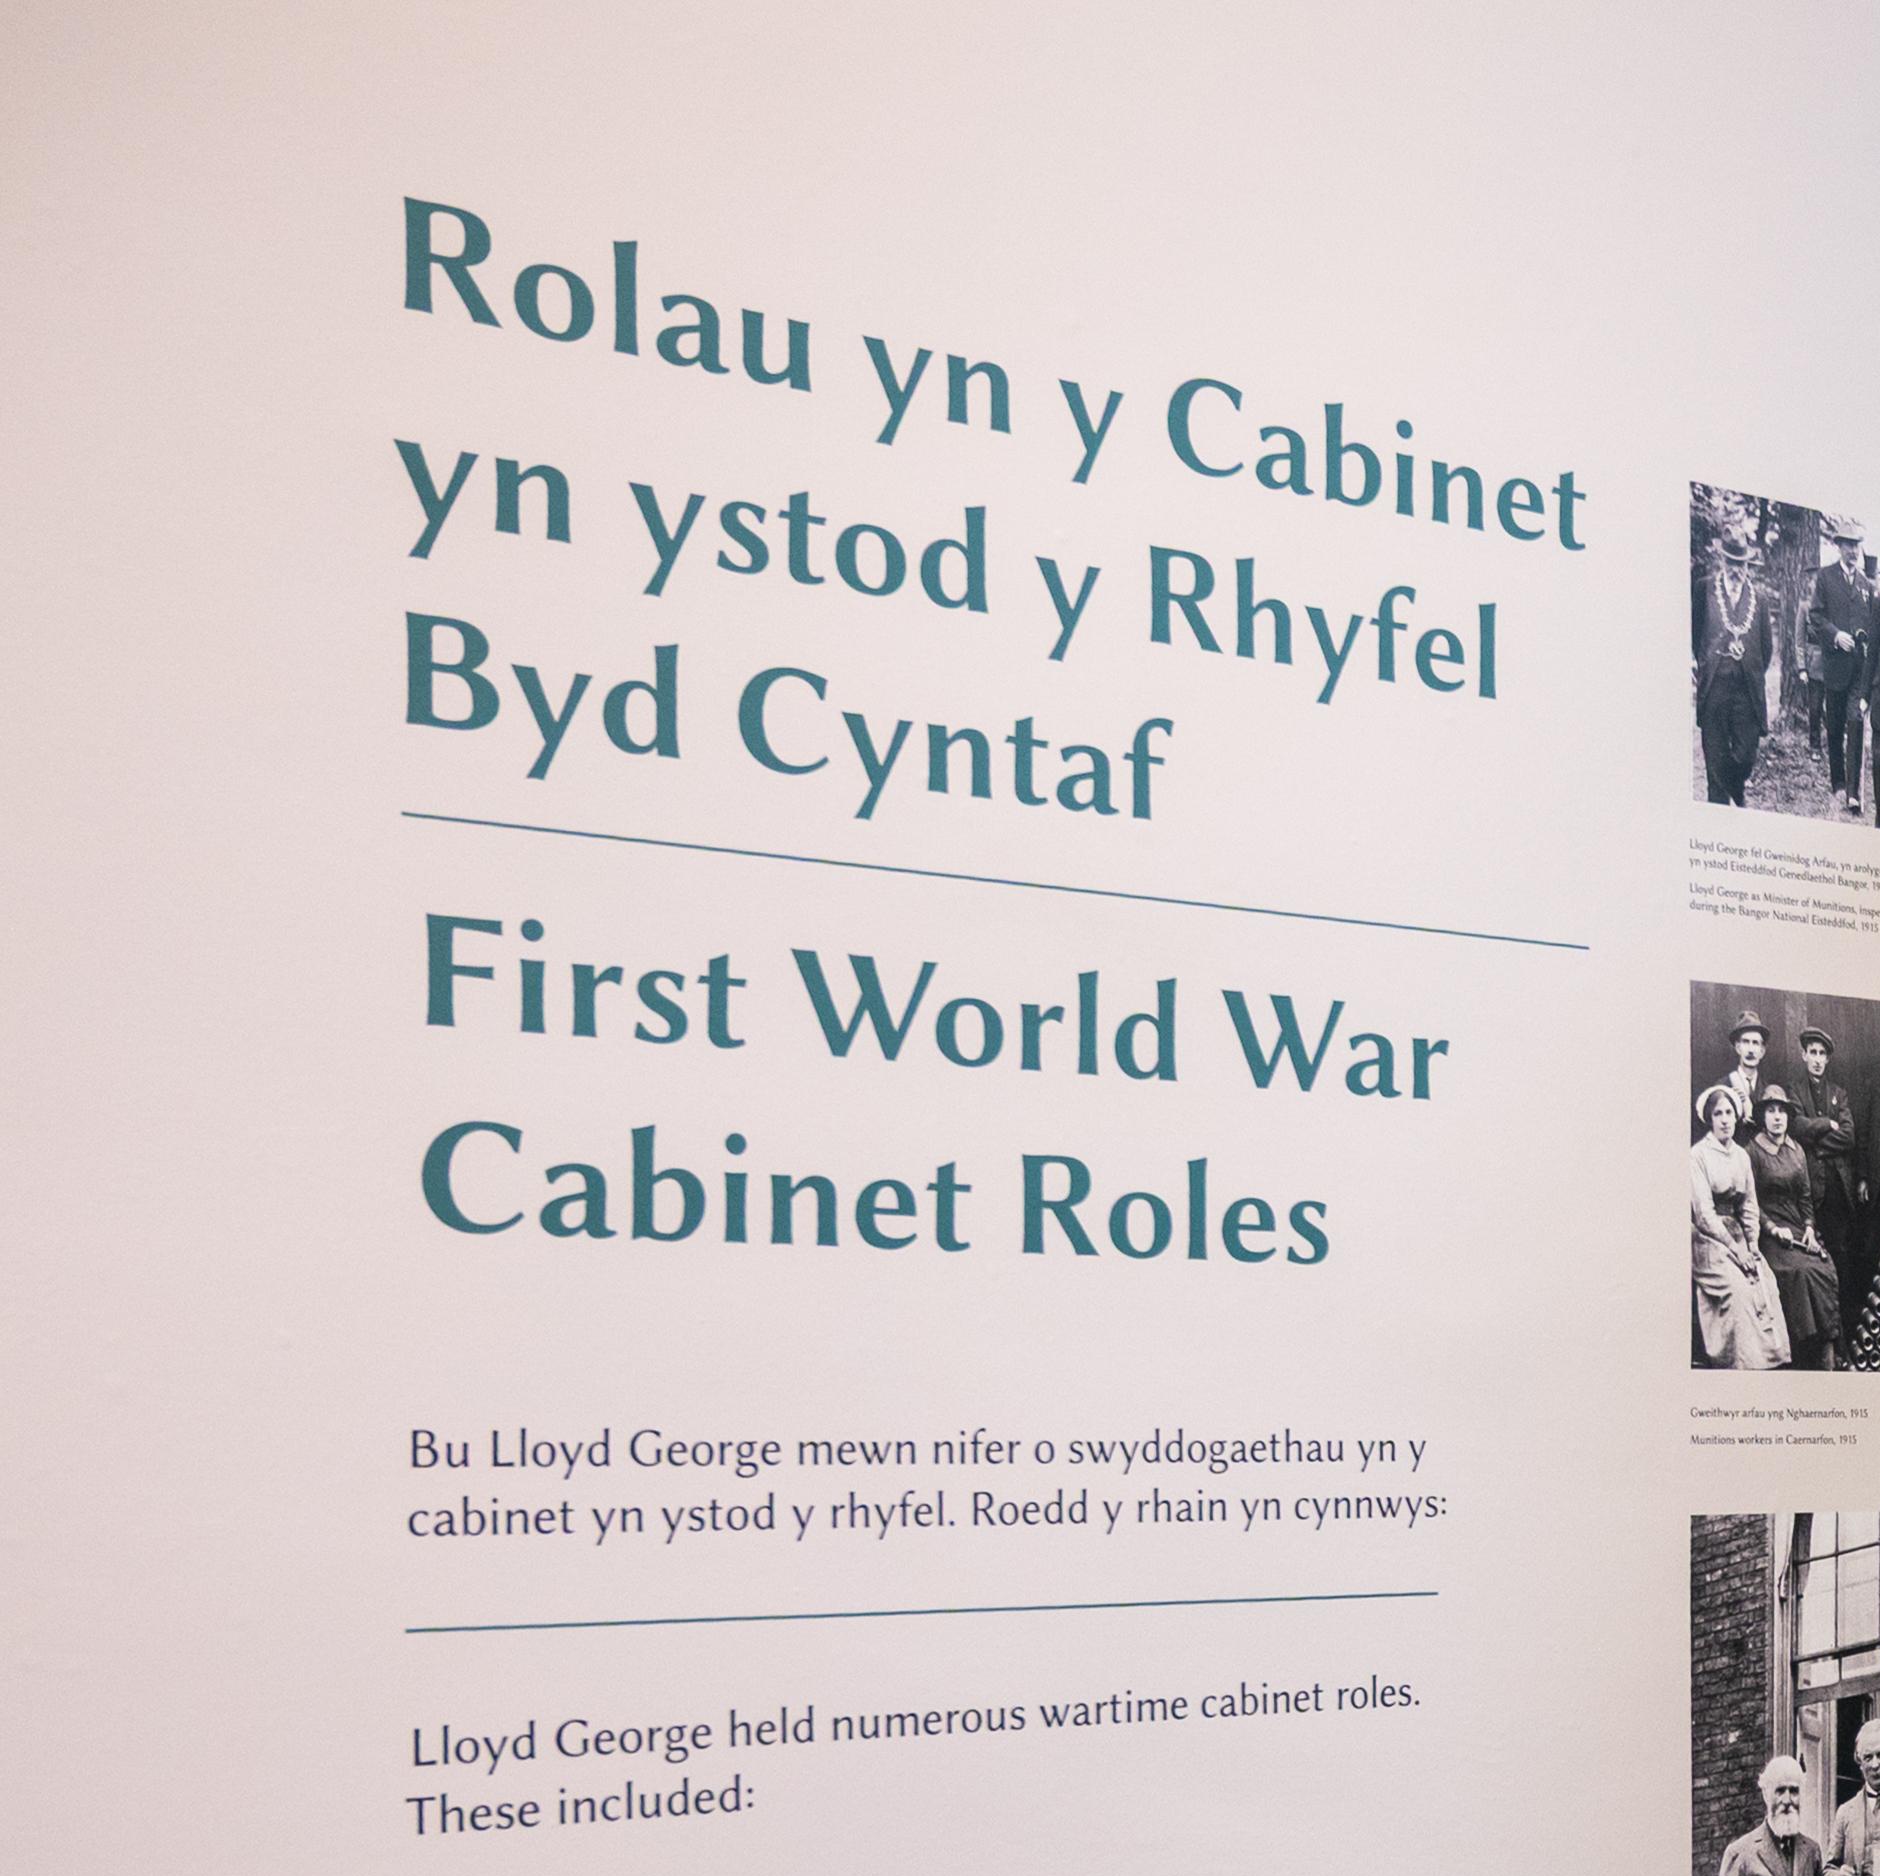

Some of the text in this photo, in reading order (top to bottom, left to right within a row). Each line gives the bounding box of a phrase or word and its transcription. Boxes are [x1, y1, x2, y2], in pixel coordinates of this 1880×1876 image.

[402, 195, 1587, 552] Rolau yn y Cabinet
[392, 437, 1497, 706] yn ystod y Rhyfel
[404, 610, 1175, 821] Byd Cyntaf
[425, 912, 1450, 1101] First World War
[420, 1120, 1330, 1266] Cabinet Roles
[407, 1487, 1447, 1547] cabinet yn ystod y rhyfel. Roedd y rhain yn cynnwys:
[410, 1427, 1427, 1481] Bu Lloyd George mewn nifer o swyddogaethau yn y
[412, 1673, 1421, 1776] Lloyd George held numerous wartime cabinet roles.
[404, 1773, 754, 1836] These included:
